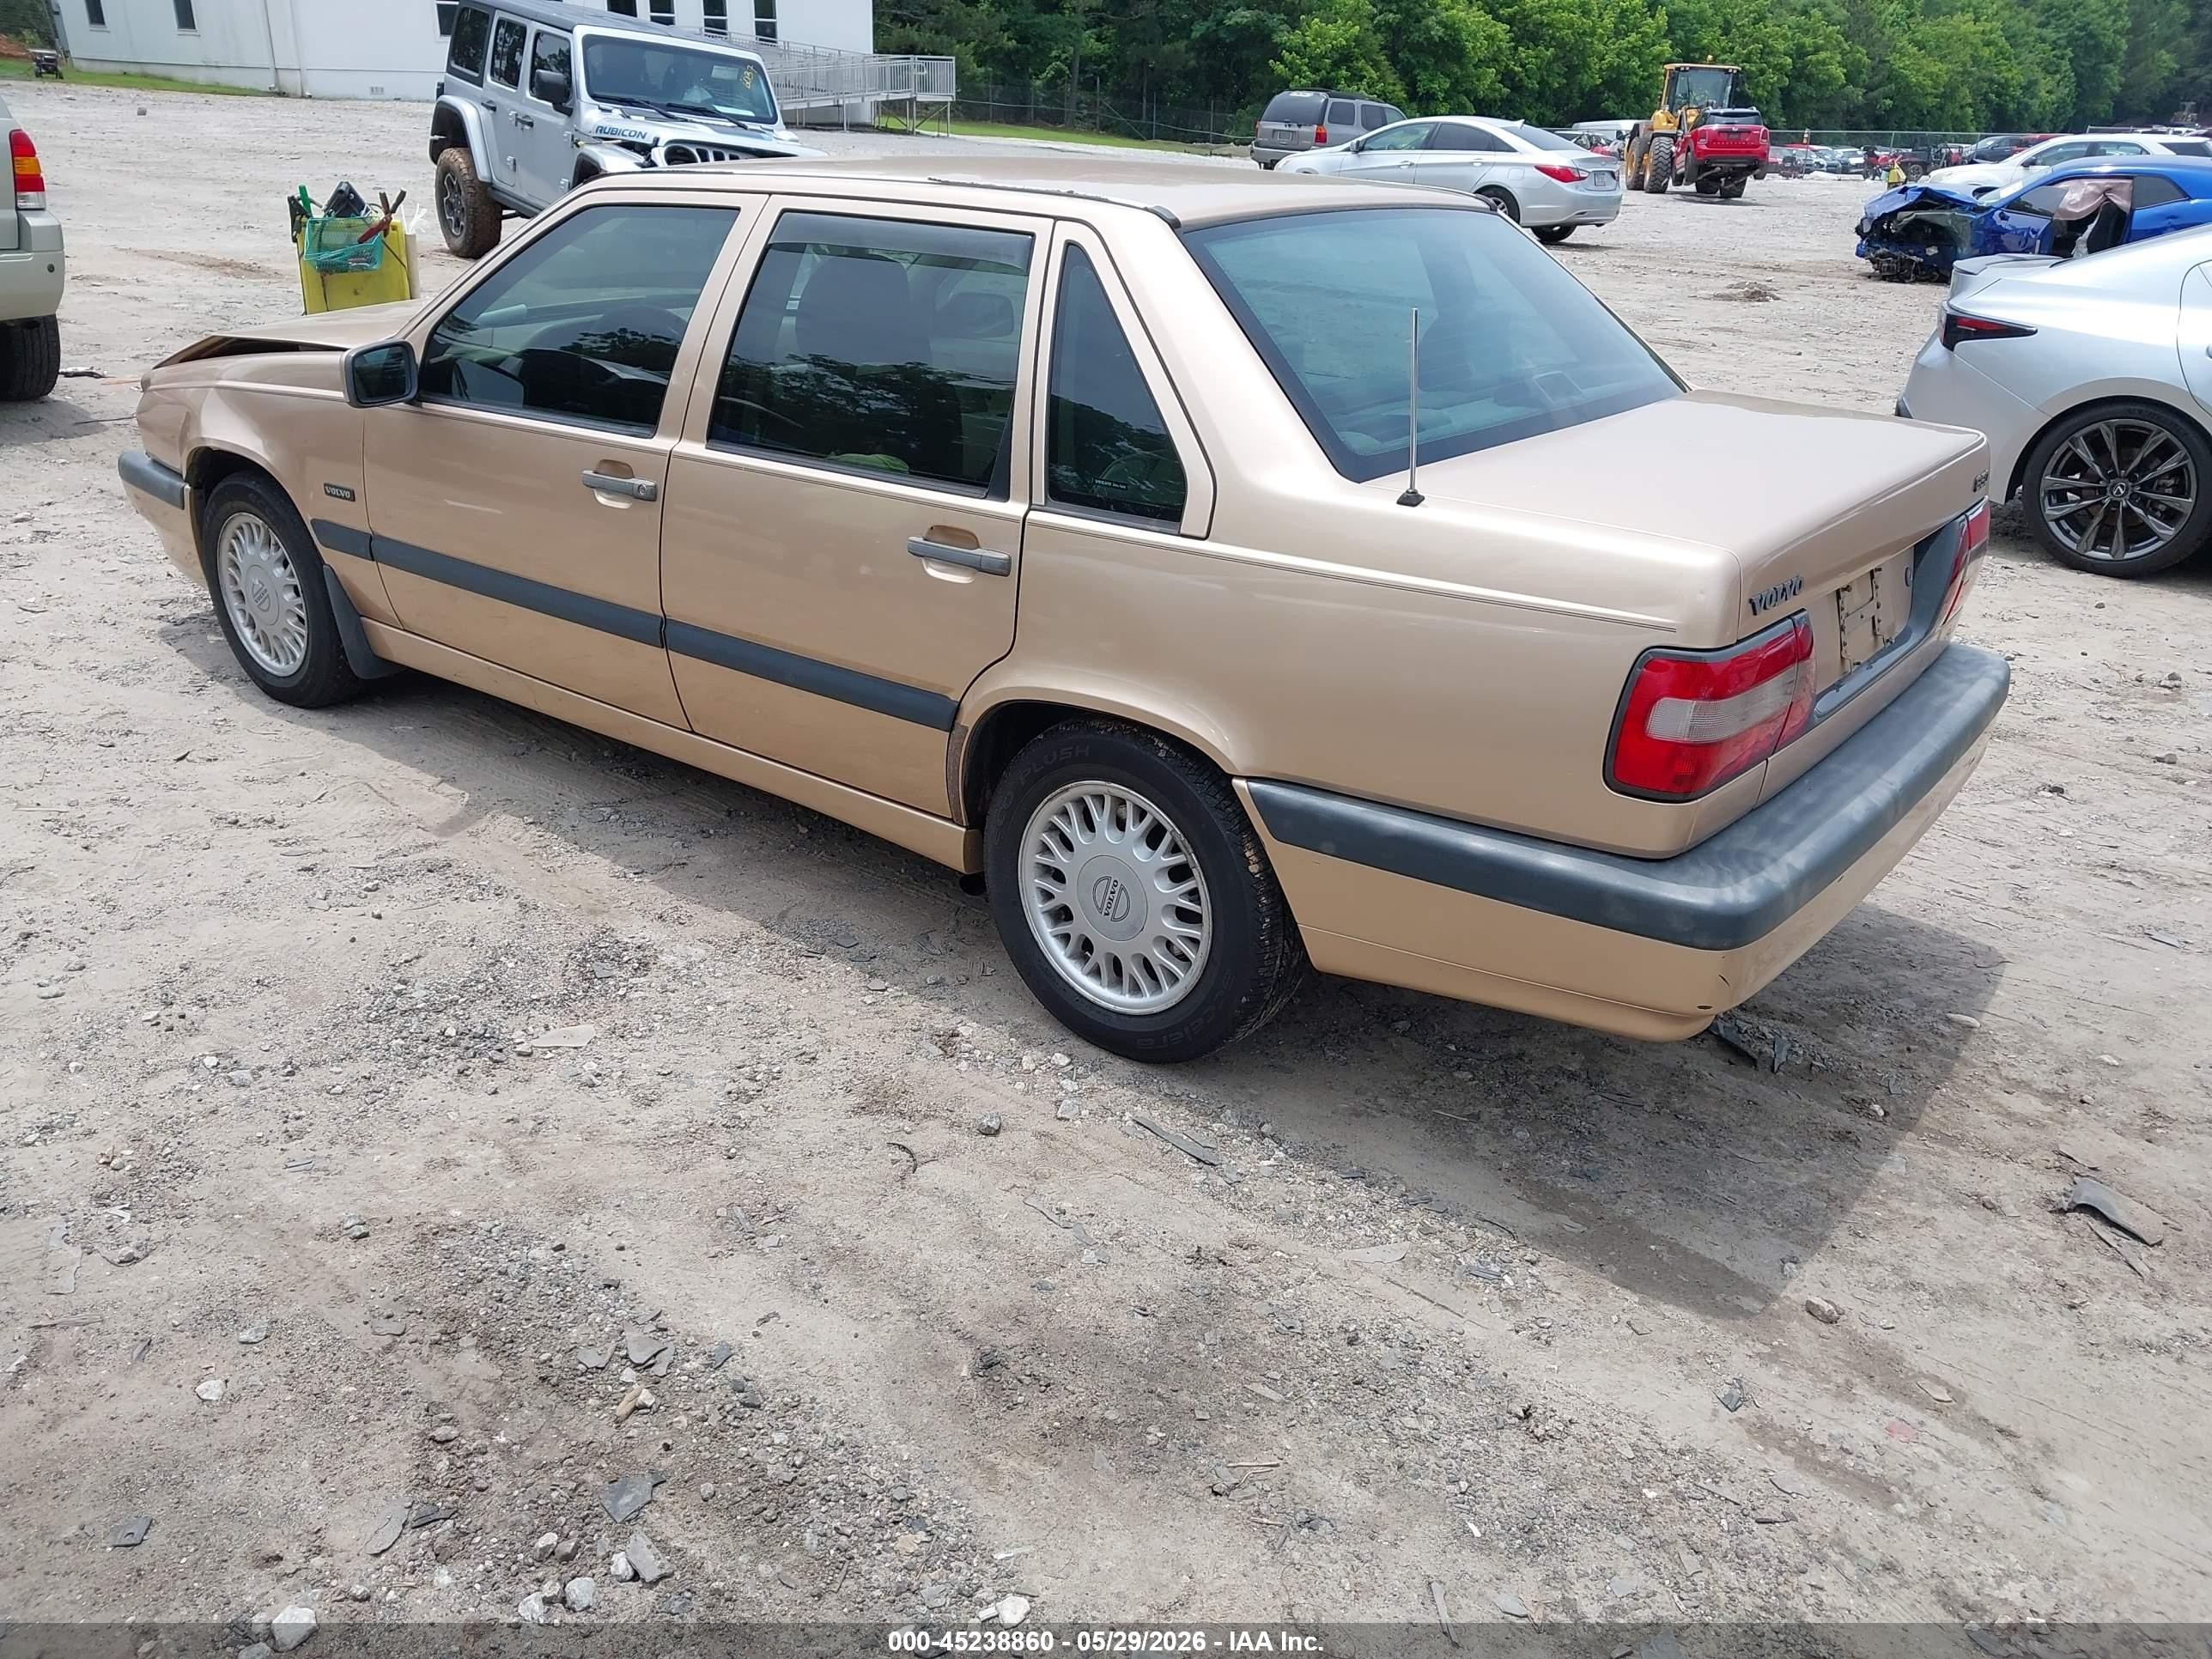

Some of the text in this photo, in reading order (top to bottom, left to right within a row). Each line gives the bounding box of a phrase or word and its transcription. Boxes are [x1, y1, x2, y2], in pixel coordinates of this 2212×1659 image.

[595, 125, 648, 140] RUBICON
[325, 486, 350, 499] VOLVO
[1749, 574, 1806, 616] VOLVO
[1103, 878, 1119, 918] VOLVO
